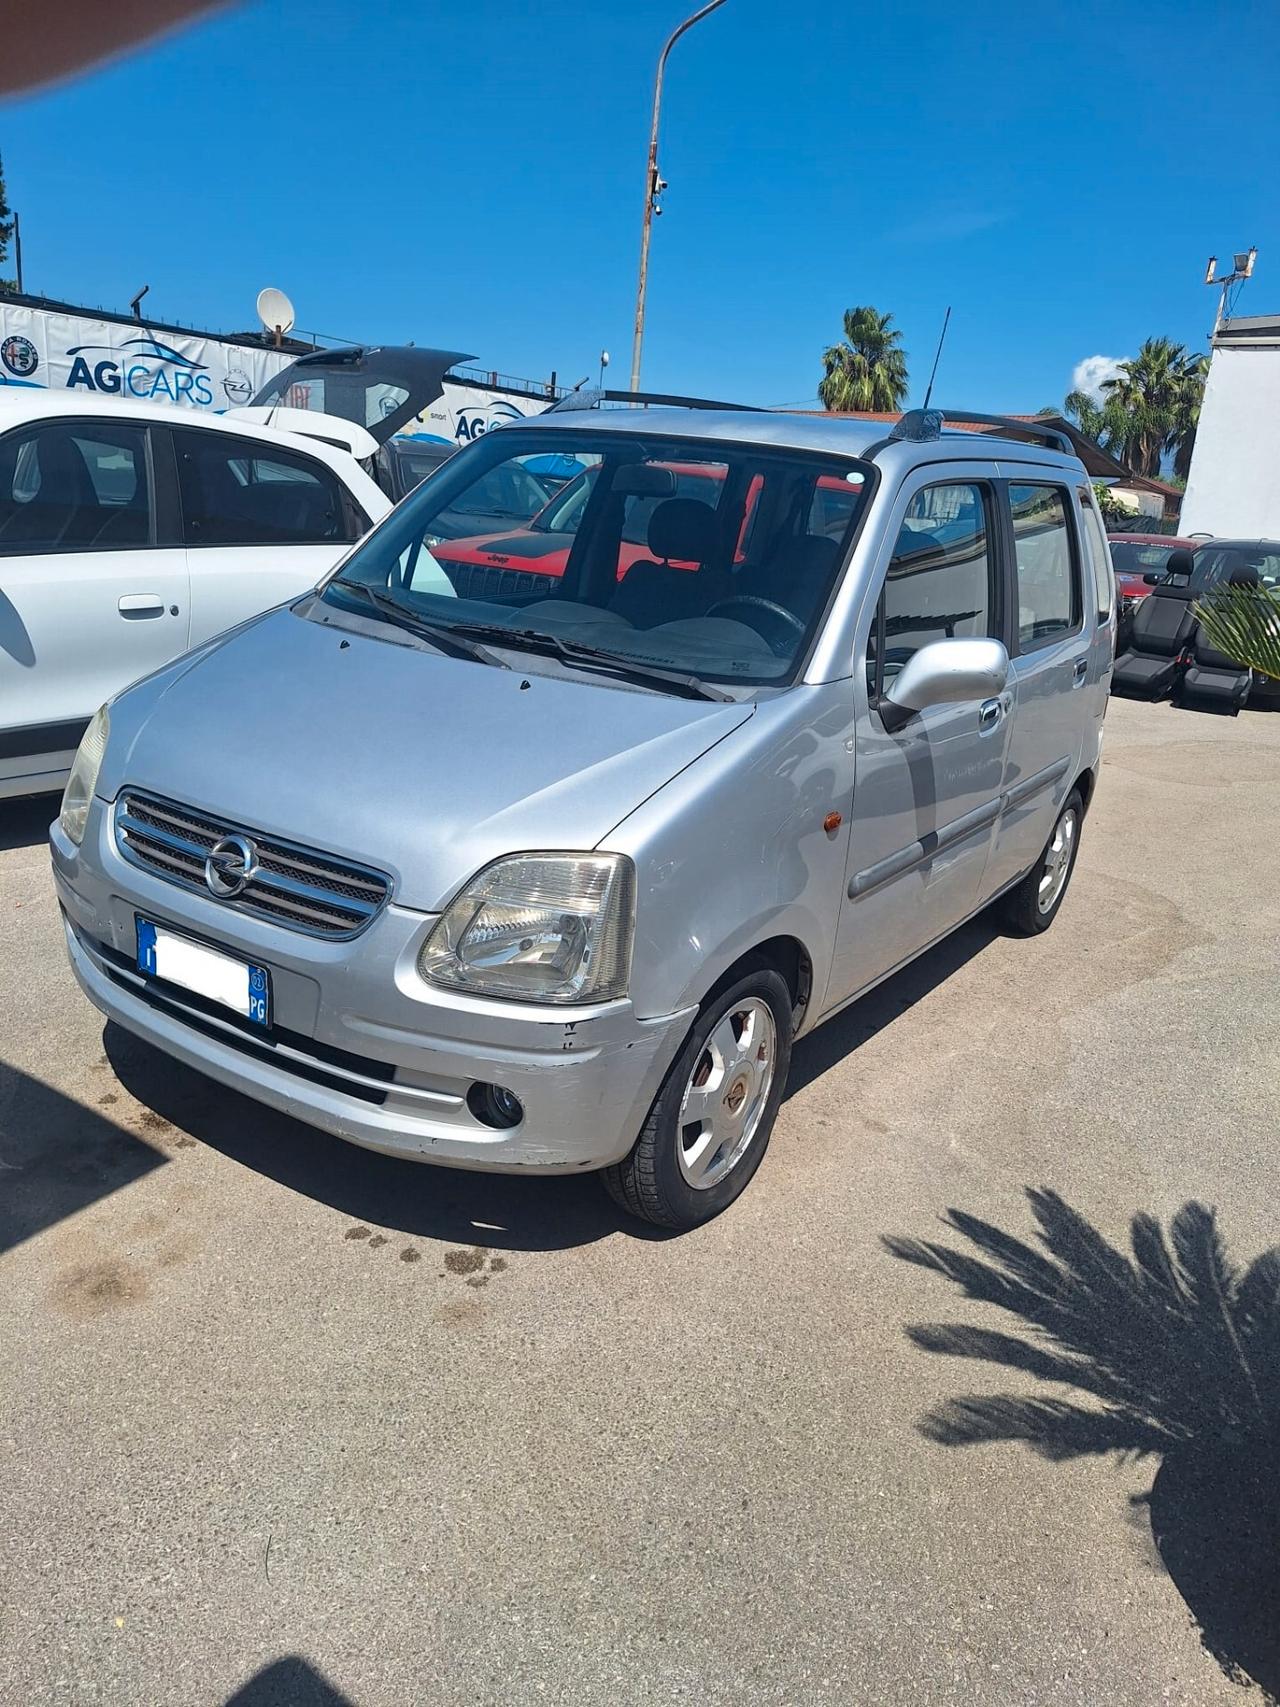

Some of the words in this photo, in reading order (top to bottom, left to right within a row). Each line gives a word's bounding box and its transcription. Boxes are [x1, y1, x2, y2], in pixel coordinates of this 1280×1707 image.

[66, 357, 121, 393] AG
[127, 365, 213, 405] CARS
[250, 995, 265, 1019] PG
